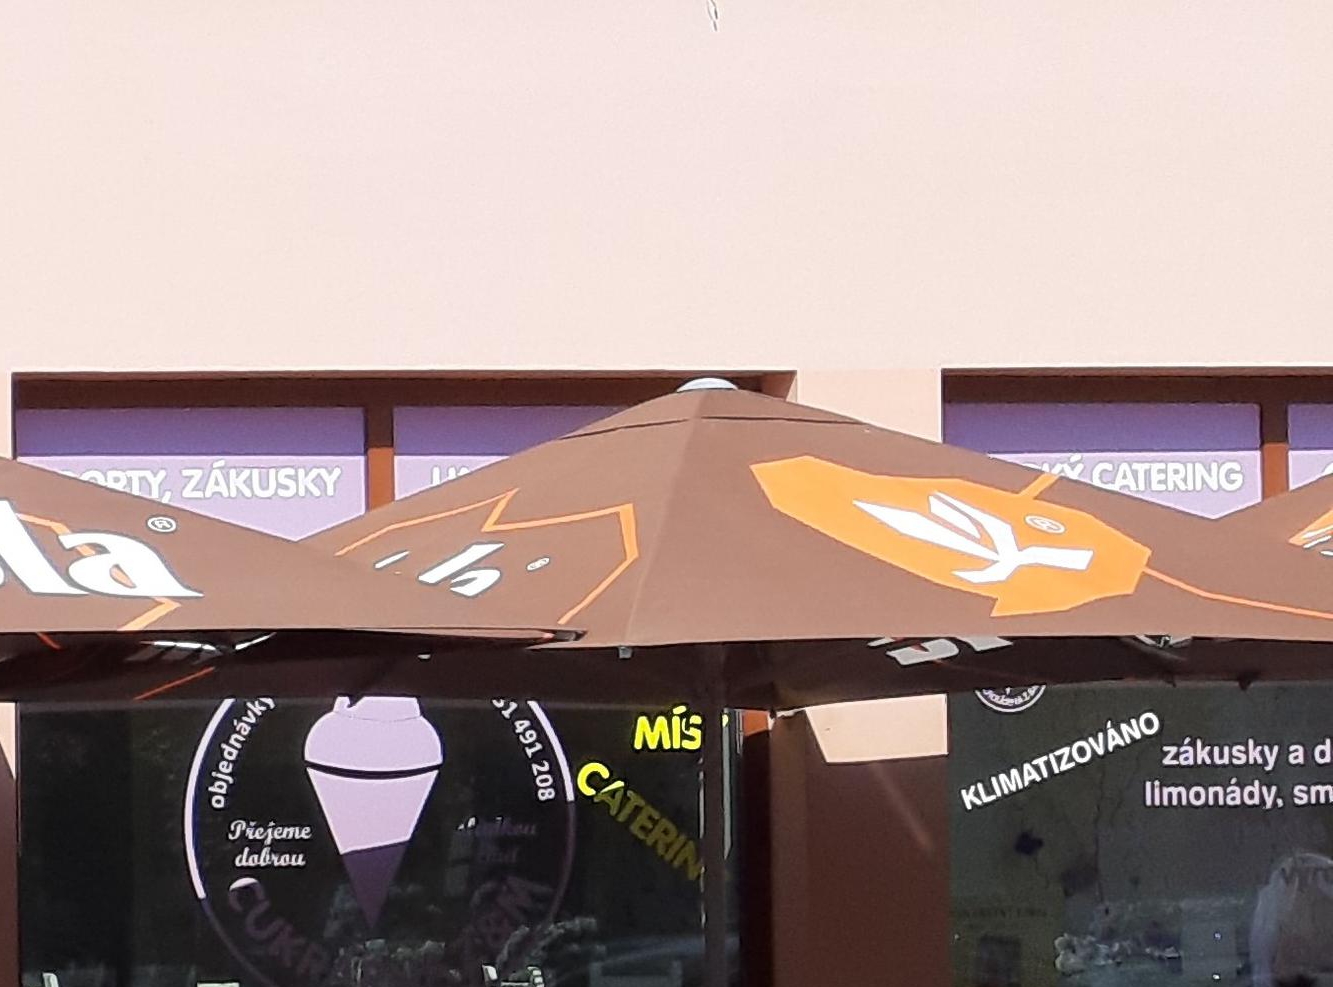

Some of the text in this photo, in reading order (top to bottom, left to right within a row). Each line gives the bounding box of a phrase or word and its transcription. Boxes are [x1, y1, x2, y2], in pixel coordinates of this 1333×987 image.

[181, 459, 342, 499] ZÁKUSKY
[1092, 461, 1244, 492] CATERING
[634, 705, 703, 750] MÍS
[208, 697, 276, 809] objednávky
[514, 720, 544, 759] 491
[531, 760, 556, 802] 208
[960, 711, 1161, 811] KLIMATIZOVÁNO
[1162, 737, 1279, 771] zákusky
[1288, 744, 1305, 765] a
[1145, 777, 1284, 810] limonády,
[228, 819, 313, 846] Přejeme
[577, 762, 702, 880] CATERIN
[235, 847, 307, 867] dobrou
